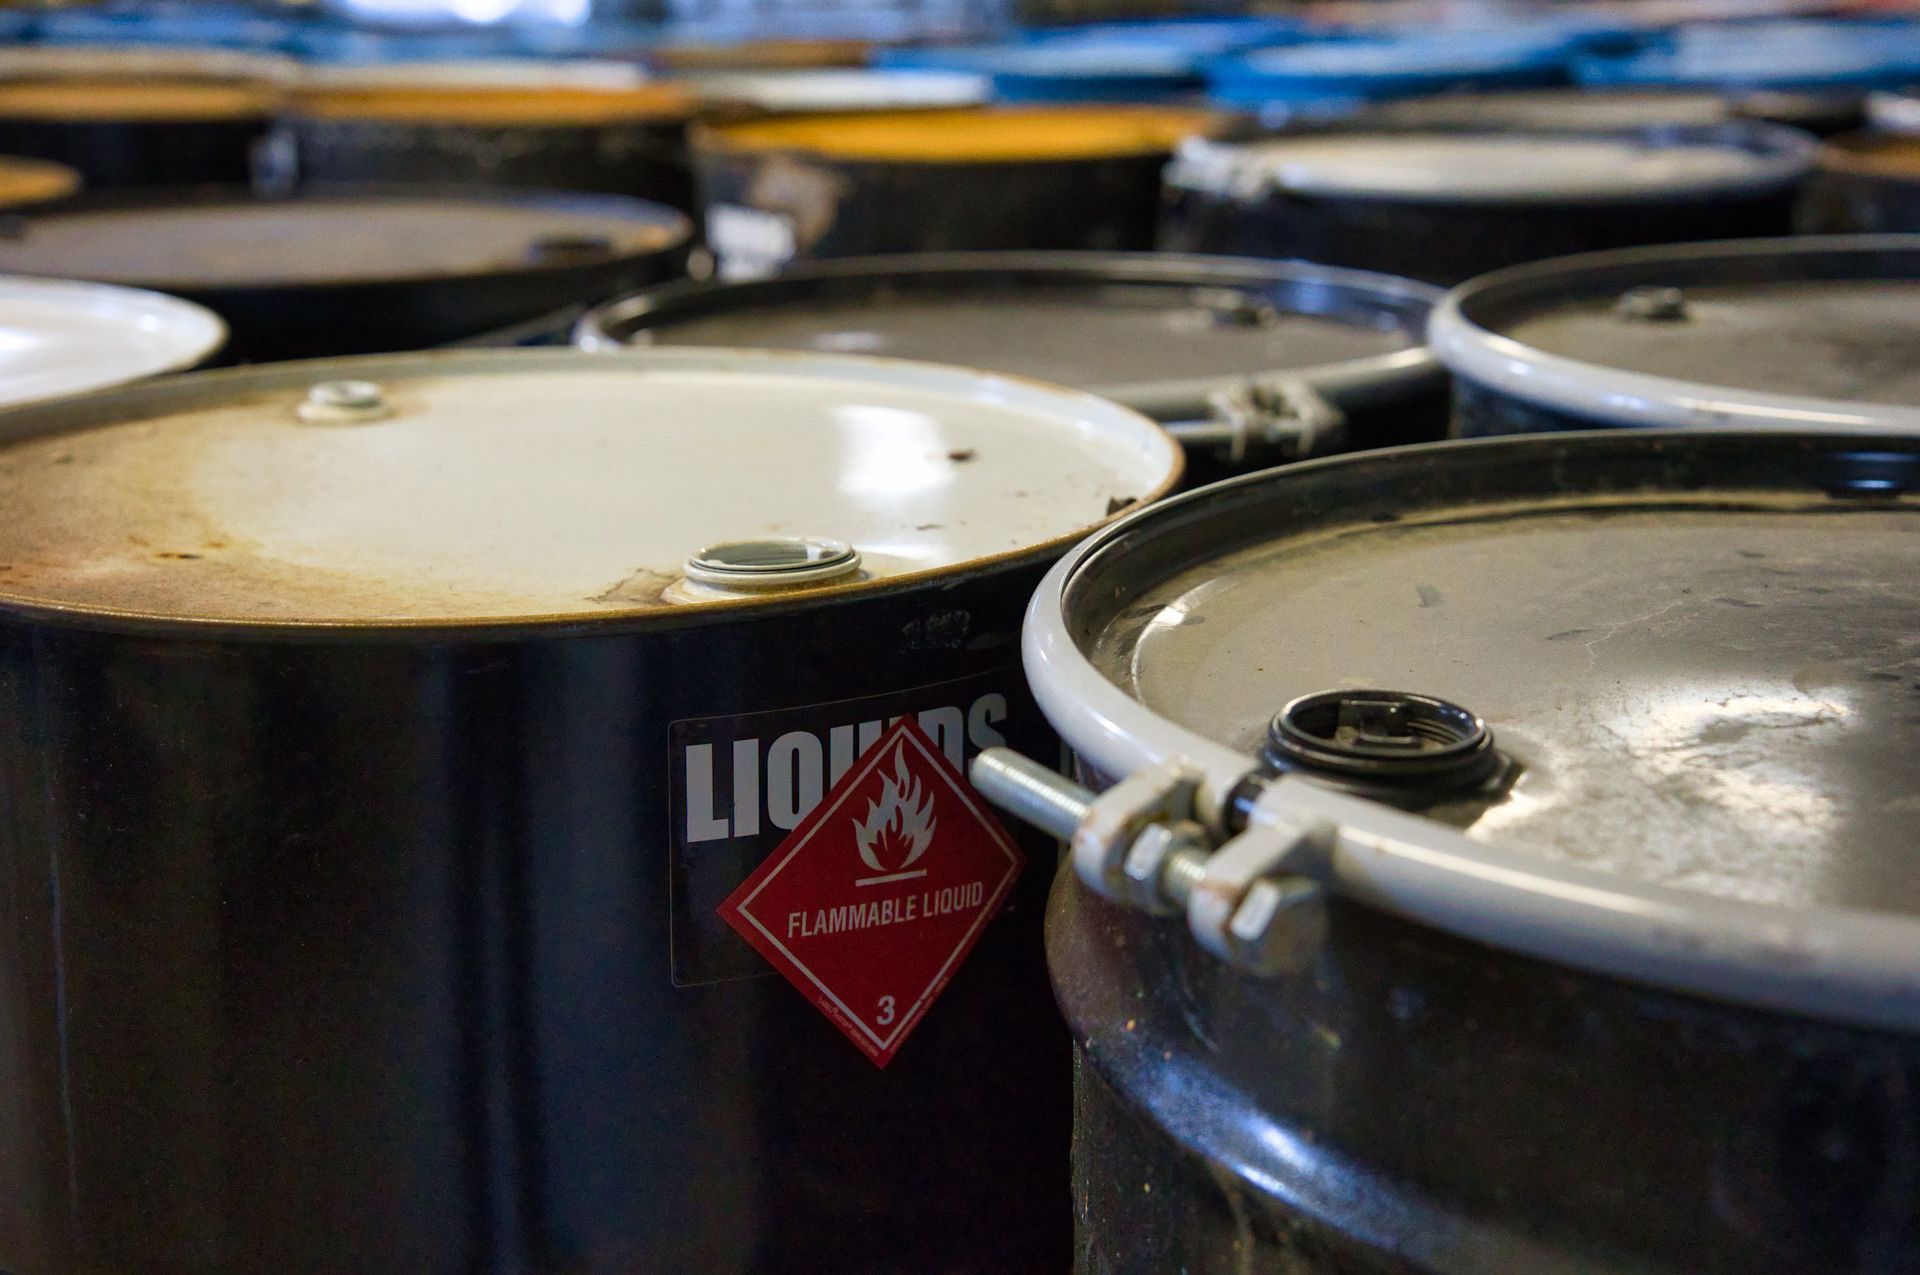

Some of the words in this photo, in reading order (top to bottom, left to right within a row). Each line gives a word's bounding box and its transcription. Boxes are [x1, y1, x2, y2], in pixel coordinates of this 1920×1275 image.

[686, 693, 1007, 843] LIQDS
[787, 895, 917, 938] FLAMMABLE
[923, 881, 984, 918] LIQUID
[876, 995, 896, 1026] 3
